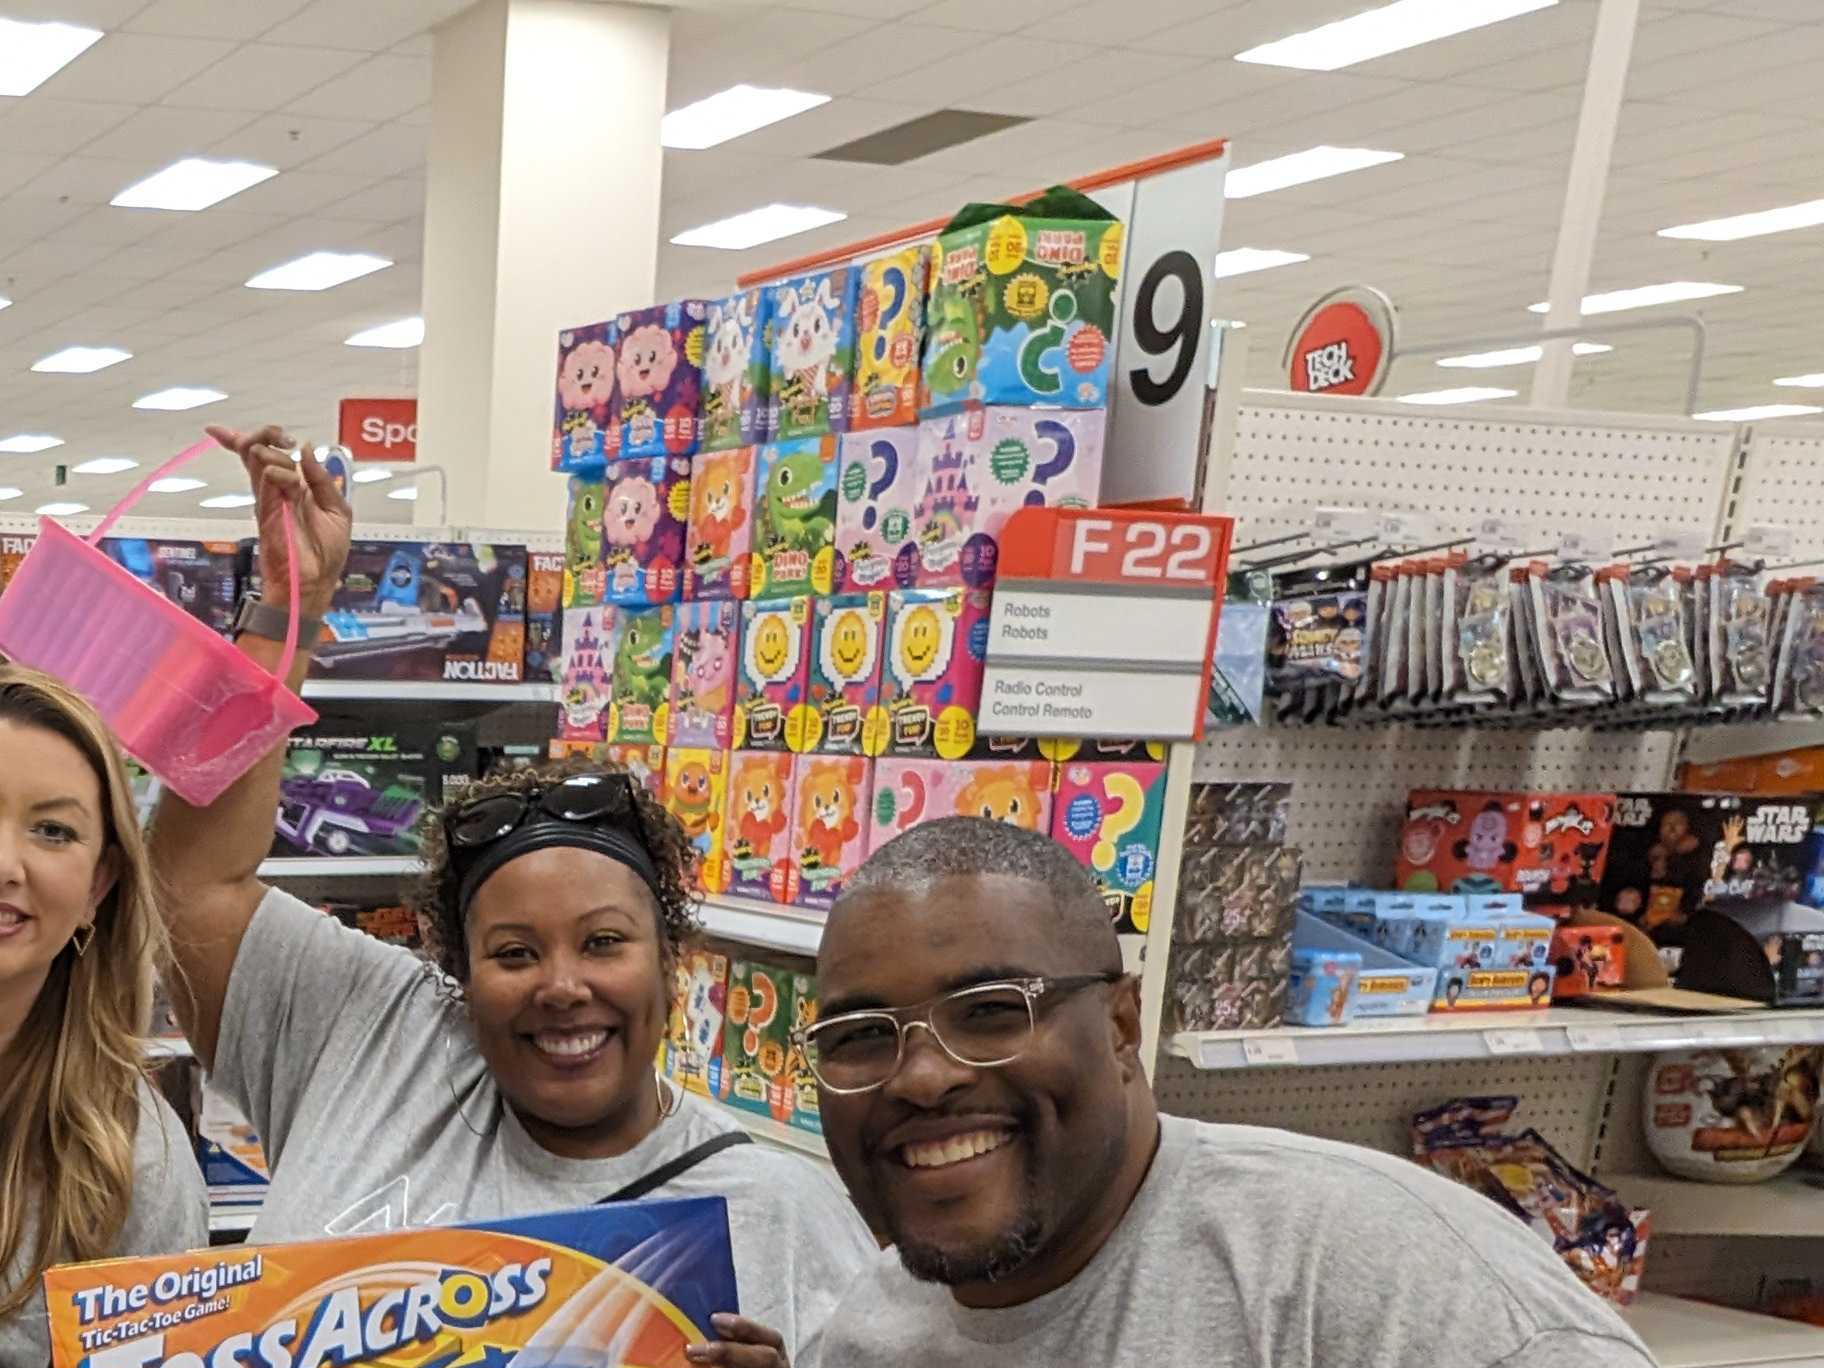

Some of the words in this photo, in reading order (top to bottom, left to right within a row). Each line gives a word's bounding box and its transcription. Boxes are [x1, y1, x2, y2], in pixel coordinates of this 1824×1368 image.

[1129, 250, 1205, 407] 9
[1305, 341, 1348, 372] TECH
[1308, 358, 1355, 391] DECK
[774, 552, 808, 566] DINO
[1070, 520, 1113, 574] F
[1121, 523, 1212, 580] 22
[1004, 602, 1051, 619] Robots
[1001, 624, 1048, 640] Robots
[443, 660, 519, 681] FACTION
[994, 680, 1032, 696] Radio
[1035, 682, 1083, 698] Control
[992, 702, 1040, 717] Control
[1042, 703, 1093, 719] Remoto
[367, 735, 397, 752] XL
[1747, 805, 1810, 826] STAR
[1747, 822, 1809, 844] WARS
[78, 1287, 147, 1322] The
[155, 1255, 263, 1305] Original
[81, 1305, 182, 1350] Tic-Tac-Toe
[184, 1296, 231, 1320] Game!
